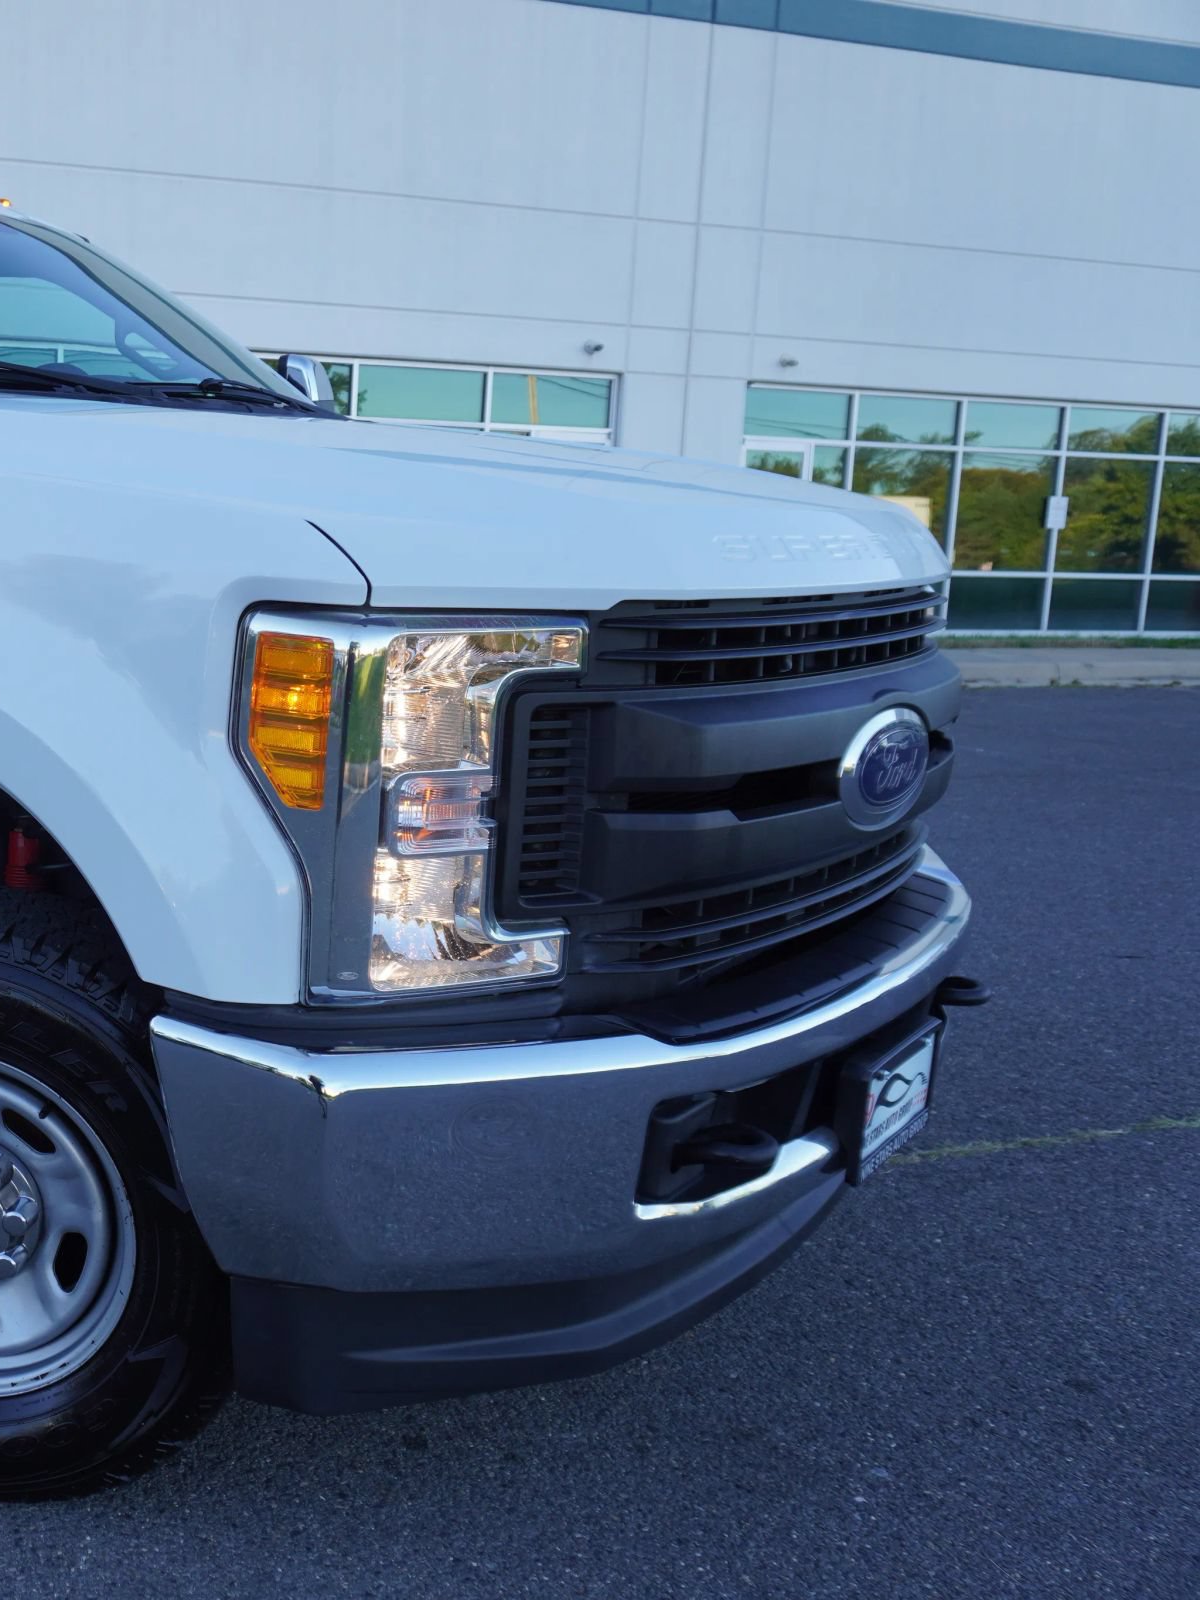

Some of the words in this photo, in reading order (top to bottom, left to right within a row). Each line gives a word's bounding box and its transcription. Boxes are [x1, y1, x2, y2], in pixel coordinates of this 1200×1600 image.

[876, 740, 918, 794] Ford
[875, 1142, 894, 1169] STARS
[893, 1129, 909, 1151] AUTO
